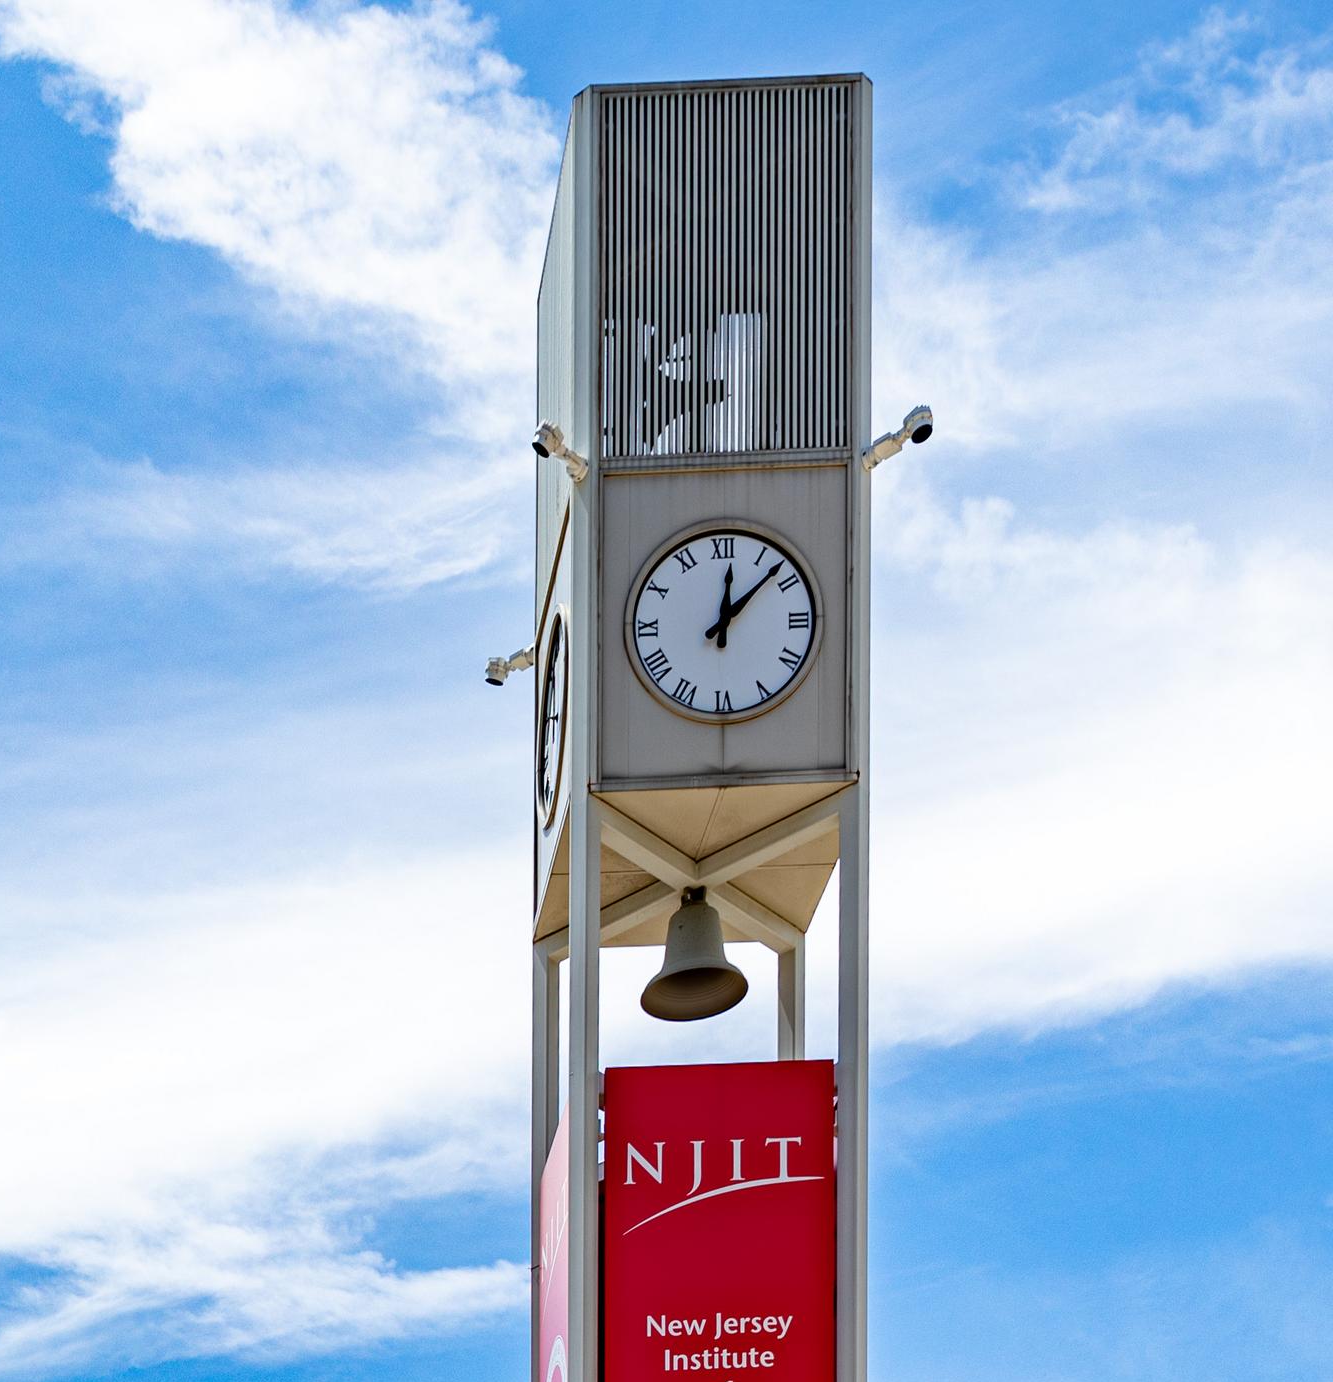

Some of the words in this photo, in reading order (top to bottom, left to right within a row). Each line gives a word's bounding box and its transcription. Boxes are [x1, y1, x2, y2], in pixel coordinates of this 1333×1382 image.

[710, 537, 735, 559] XII
[753, 546, 768, 566] I
[673, 547, 698, 574] XI
[647, 580, 669, 600] X
[777, 573, 800, 593] II
[638, 618, 658, 638] IX
[789, 611, 809, 630] III
[644, 648, 673, 683] VIII
[778, 648, 802, 671] IV
[671, 678, 698, 706] VII
[714, 690, 734, 712] VI
[755, 680, 772, 701] V
[623, 1136, 802, 1196] NJIT
[646, 1314, 706, 1337] New
[713, 1312, 793, 1339] Jersey
[664, 1347, 775, 1371] Institute
